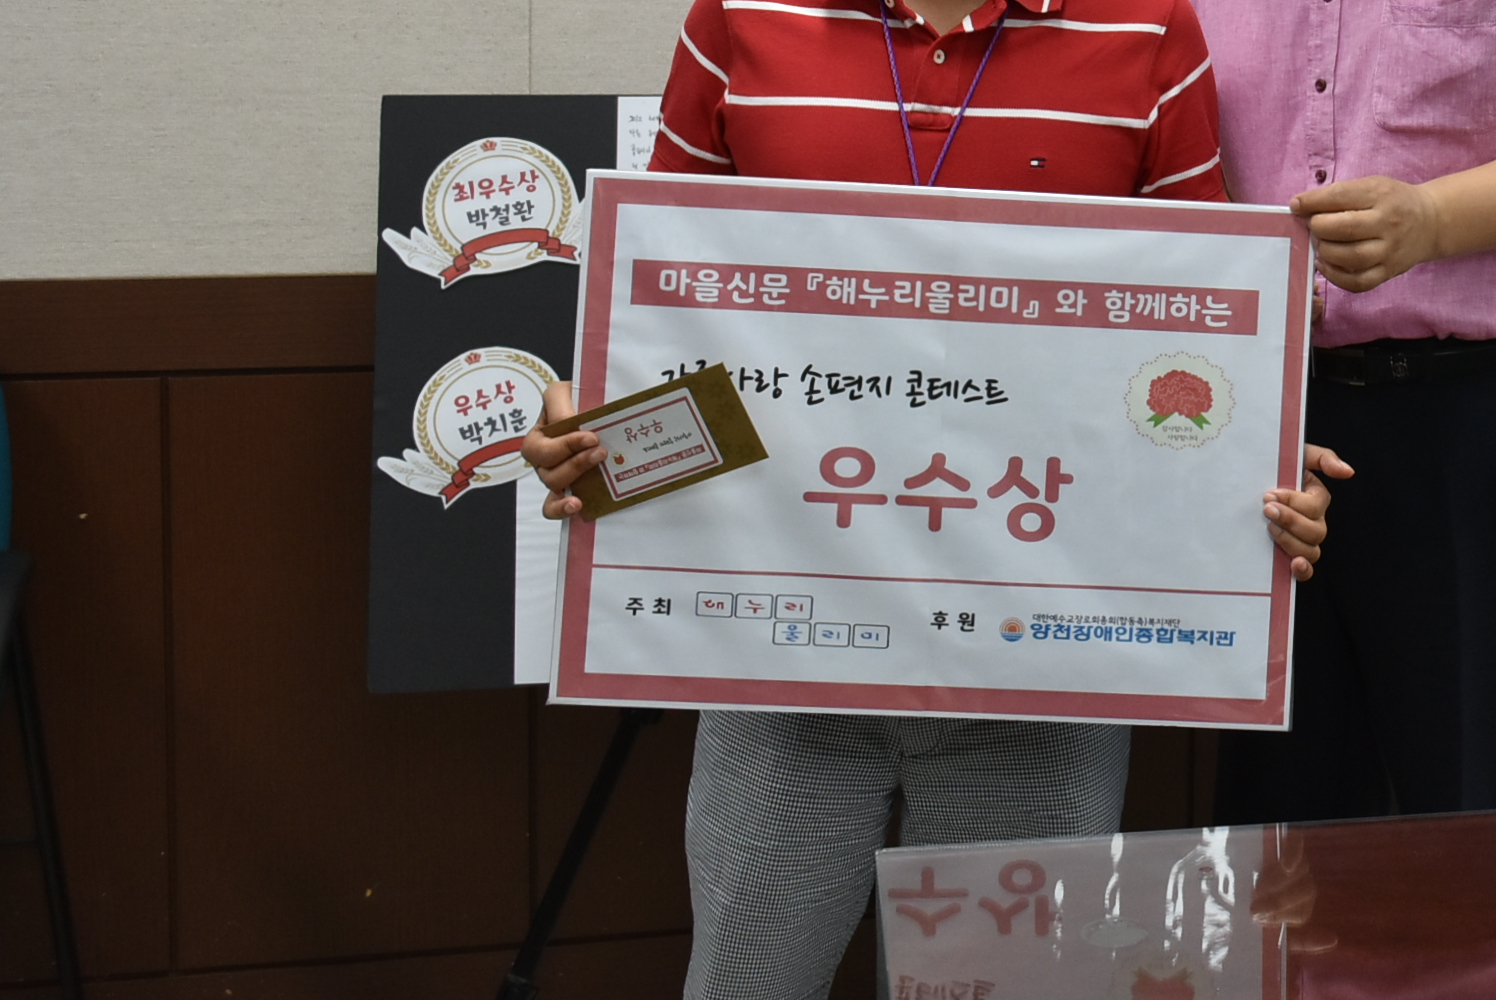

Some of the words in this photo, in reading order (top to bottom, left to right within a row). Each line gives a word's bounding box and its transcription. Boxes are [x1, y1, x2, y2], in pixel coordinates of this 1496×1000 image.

[452, 169, 540, 202] 최우수상
[466, 200, 535, 230] 박철환
[659, 268, 790, 305] 마을신문
[806, 272, 1040, 319] 『해누리울리미』
[1055, 288, 1088, 317] 와
[1104, 289, 1233, 328] 함께하는
[454, 380, 516, 417] 우수상
[800, 363, 892, 406] 손편지
[905, 369, 1009, 408] 콘테스트
[458, 408, 528, 446] 박치훈
[624, 419, 663, 444] 우수상
[802, 445, 1074, 543] 우수상
[930, 610, 976, 633] 후원
[1030, 622, 1237, 647] 양천장애인종합복지관
